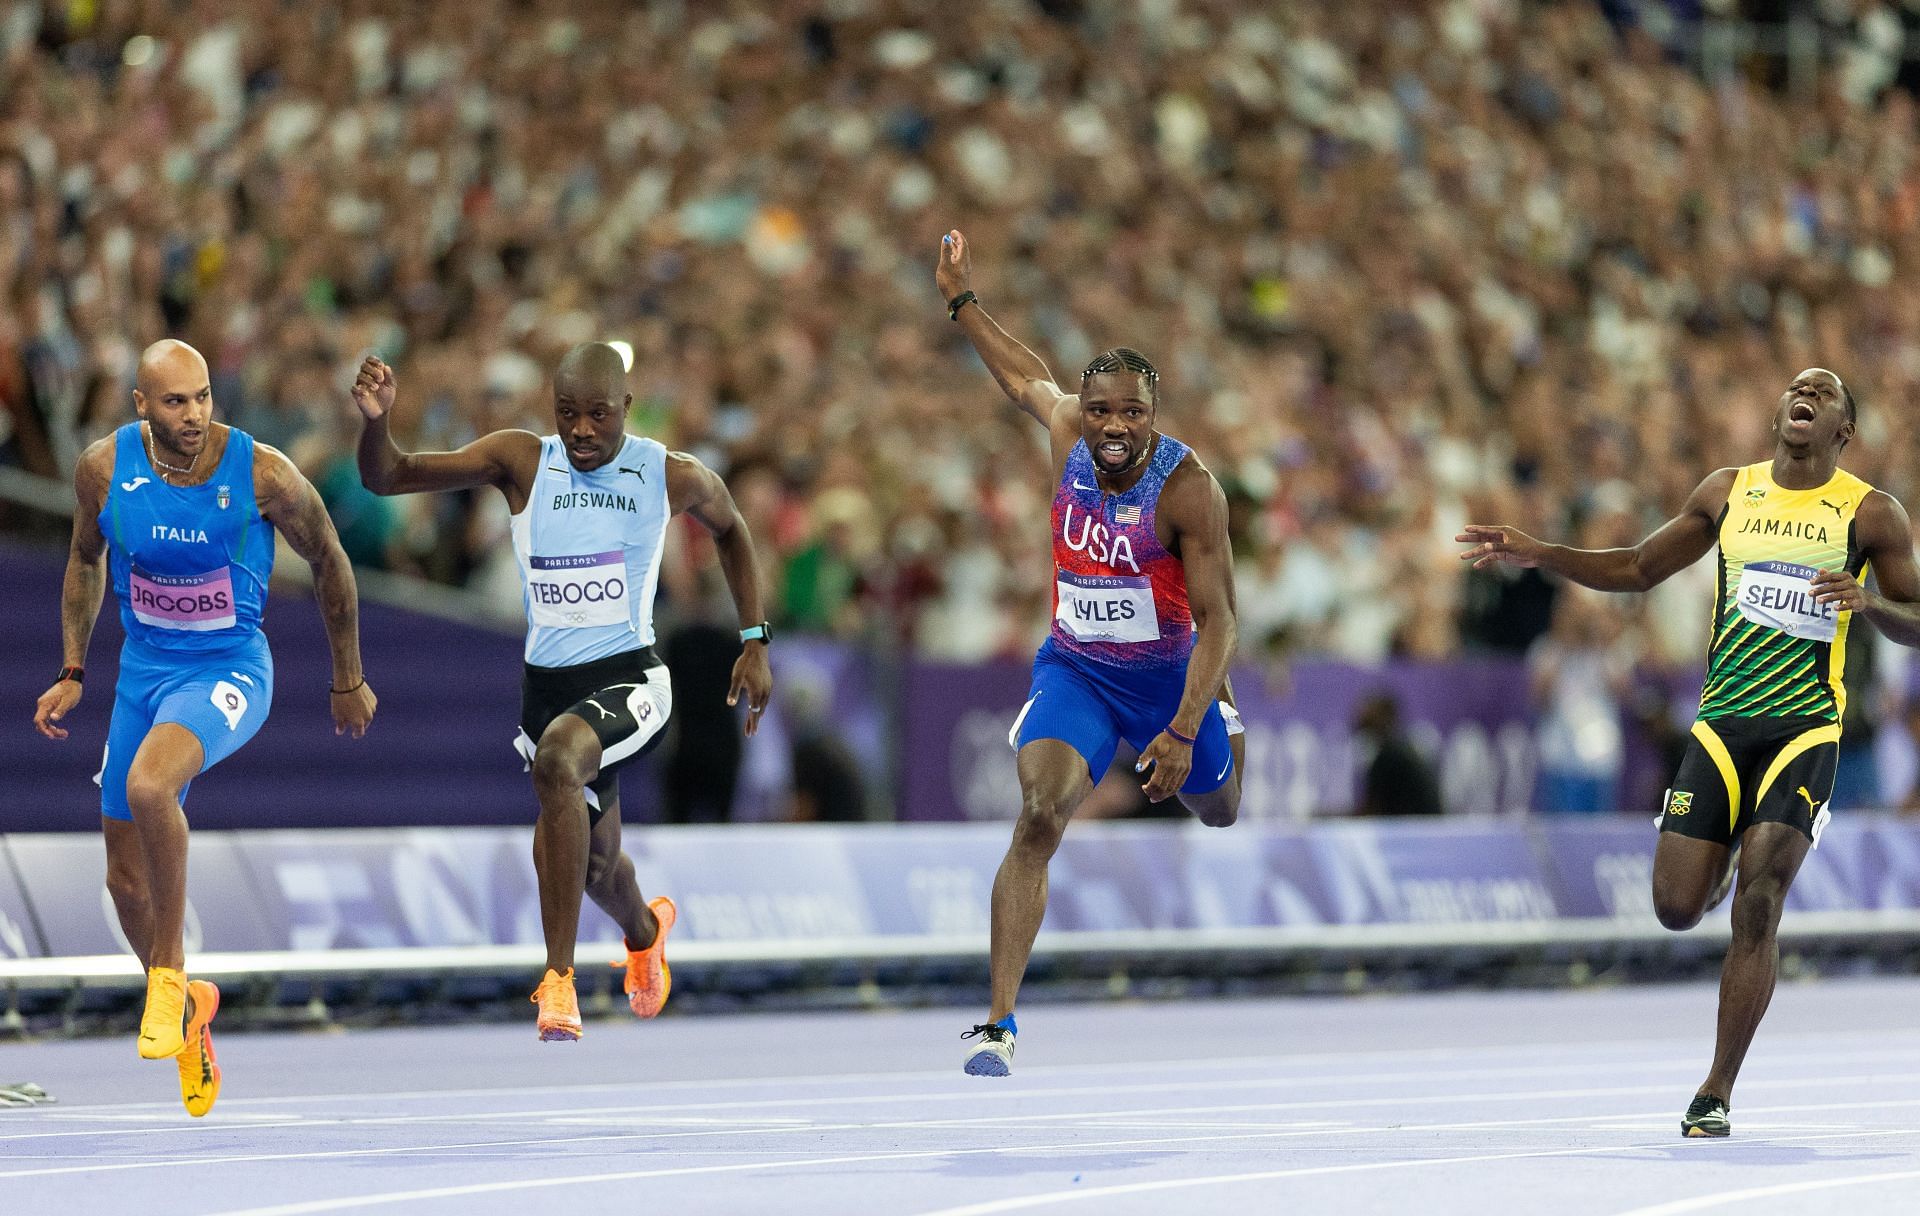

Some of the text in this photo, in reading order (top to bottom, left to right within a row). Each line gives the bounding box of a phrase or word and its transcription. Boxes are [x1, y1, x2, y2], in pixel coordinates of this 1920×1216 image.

[553, 492, 638, 514] BOTSWANA
[152, 525, 209, 544] ITALIA
[1063, 503, 1140, 574] USA
[1738, 518, 1828, 544] JAMAICA
[544, 557, 597, 567] PARIS 2024
[1770, 563, 1821, 579] PARIS 202
[151, 575, 178, 585] PARIS
[1074, 577, 1097, 585] PARIS
[133, 584, 229, 614] JACOBS
[530, 578, 624, 605] TEBOGO
[1073, 597, 1136, 622] LYLES
[1745, 584, 1834, 621] SEVILLE
[225, 692, 239, 711] 9
[637, 701, 652, 722] 8
